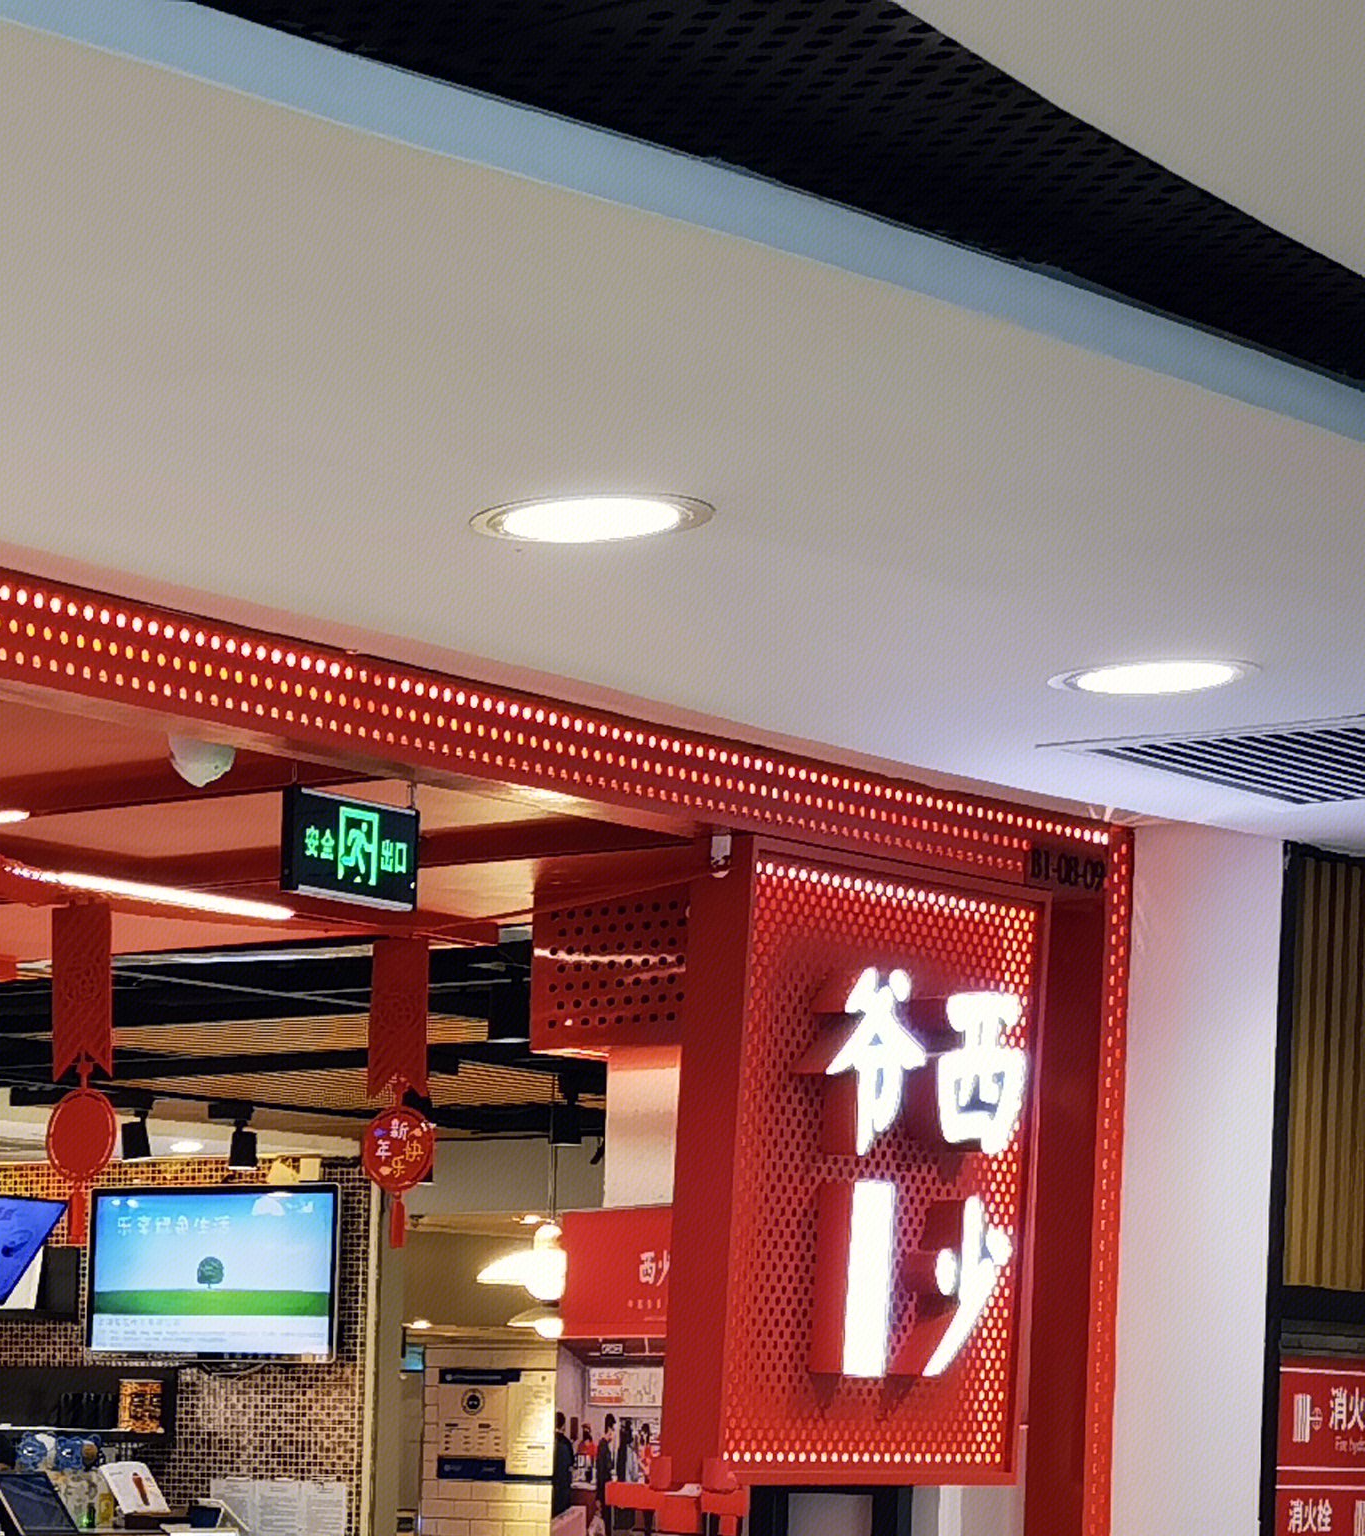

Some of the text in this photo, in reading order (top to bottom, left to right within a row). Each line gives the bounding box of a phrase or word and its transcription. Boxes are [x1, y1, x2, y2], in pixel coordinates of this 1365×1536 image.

[304, 825, 408, 873] 安全 出口
[1031, 848, 1107, 892] B1-08-09
[1329, 1386, 1365, 1431] 消火
[1287, 1498, 1333, 1534] 消火栓
